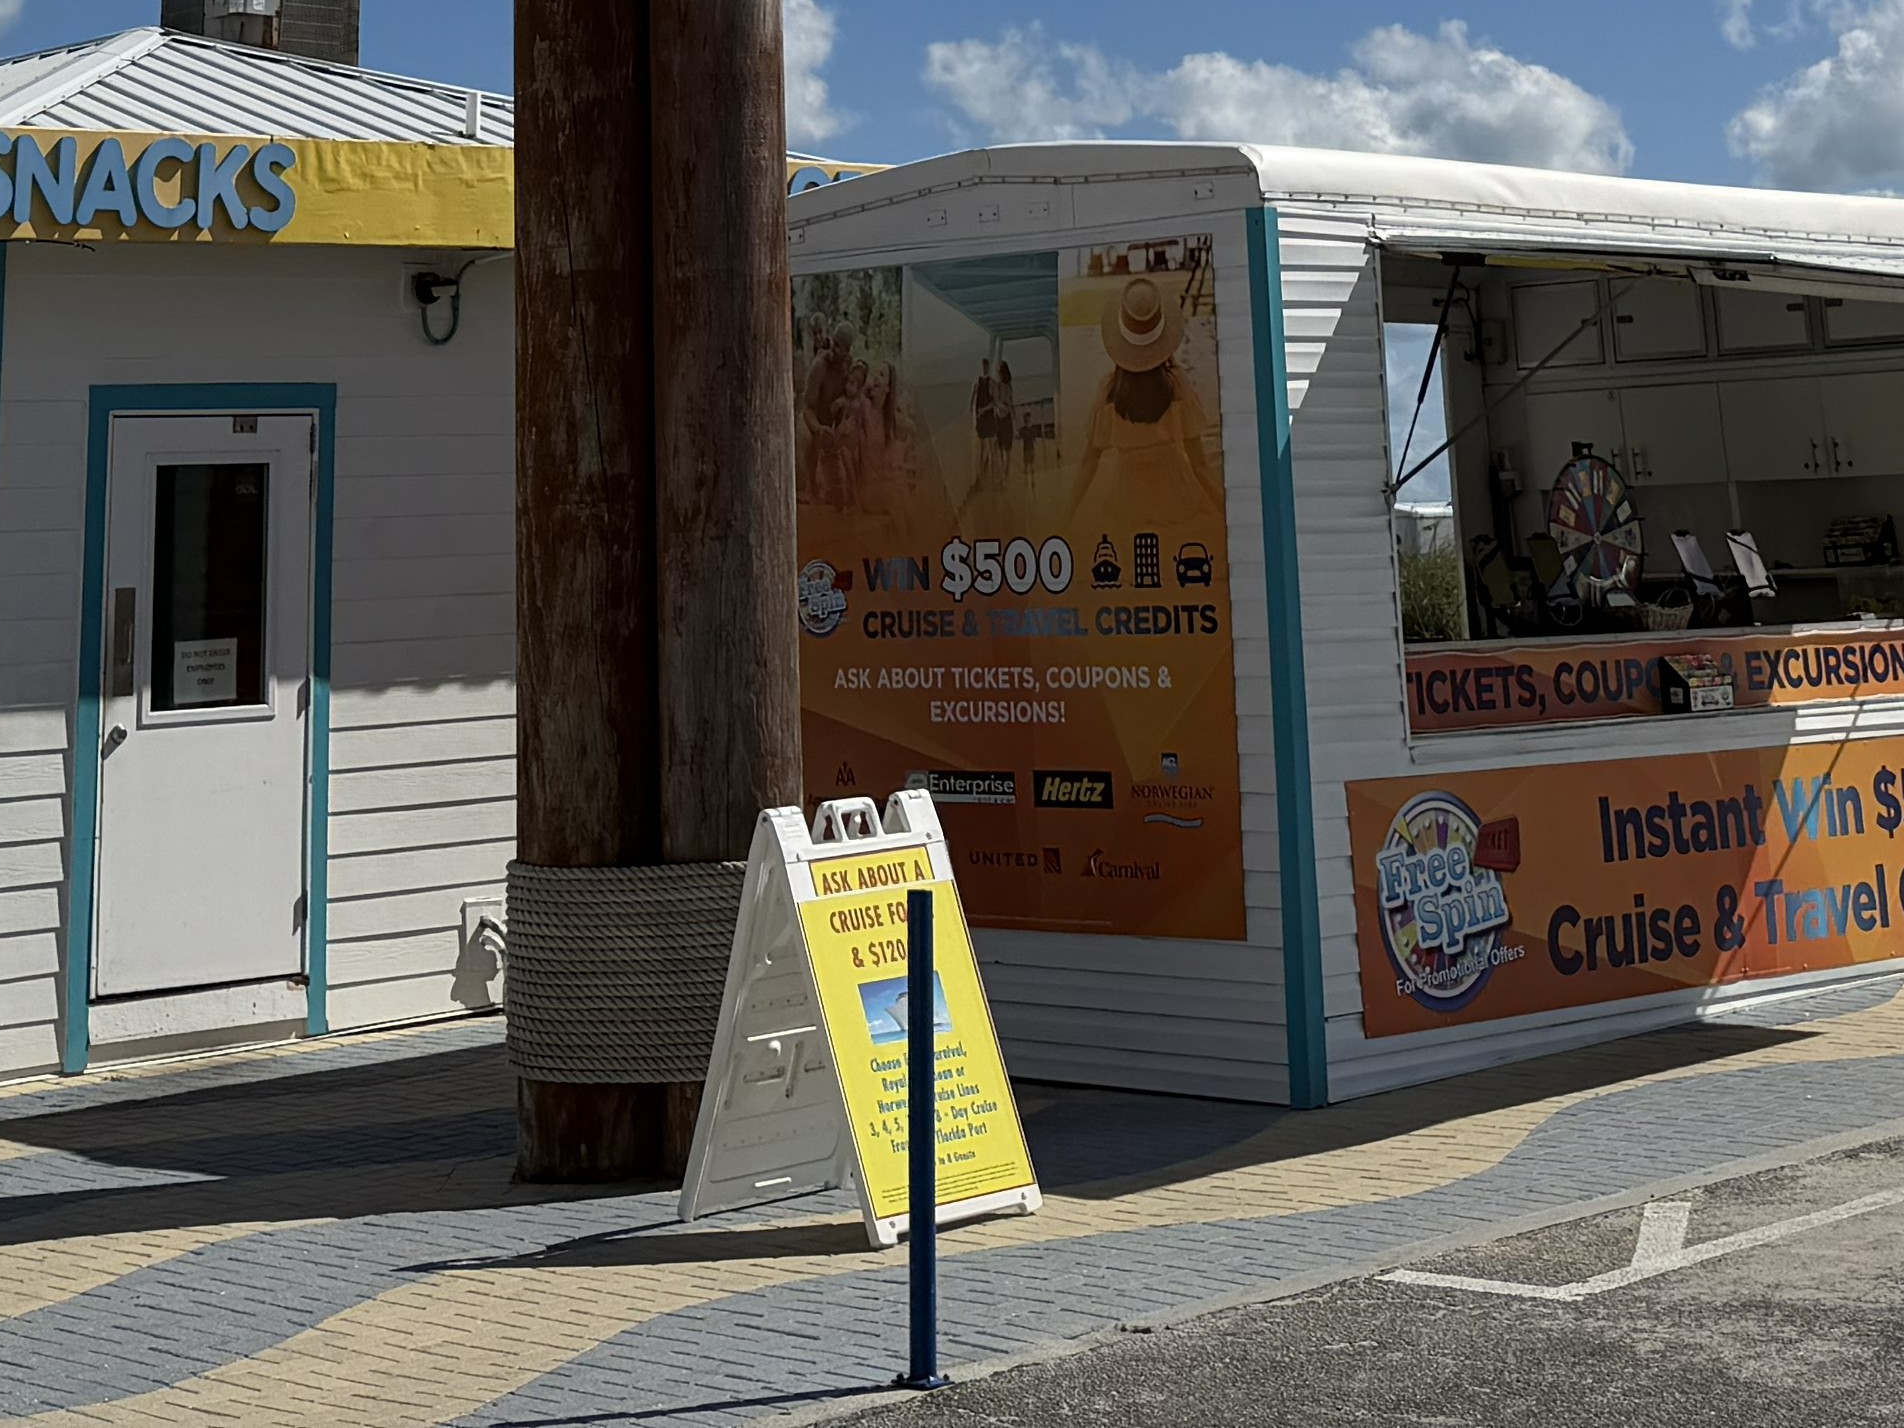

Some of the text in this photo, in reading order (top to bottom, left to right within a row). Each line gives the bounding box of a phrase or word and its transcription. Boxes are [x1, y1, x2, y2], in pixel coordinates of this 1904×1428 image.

[863, 535, 1074, 602] WIN $500
[863, 604, 1218, 638] CRUISE & TRAVEL CREDITS
[834, 665, 1171, 693] ASK ABOUT TICKETS, COUPONS &
[1406, 664, 1546, 716] ICKETS,
[1553, 656, 1662, 705] COUPO
[930, 699, 1066, 724] EXCURSIONS!
[929, 773, 1014, 795] Enterprise
[1041, 776, 1106, 803] Hertz
[1131, 784, 1213, 800] NORWEGIAN
[1598, 784, 1766, 863] Instant
[1772, 772, 1864, 844] Win
[822, 859, 925, 895] ASK ABOUT A
[969, 851, 1160, 881] UNITED Carnival
[1380, 843, 1466, 903] Free
[830, 901, 908, 934] CRUISE FO
[1416, 881, 1506, 948] Spin
[1546, 893, 1701, 976] Cruise
[1713, 884, 1746, 951] &
[1755, 863, 1890, 946] Travel
[852, 946, 865, 968] &
[1396, 944, 1526, 997] For Promotional Offers
